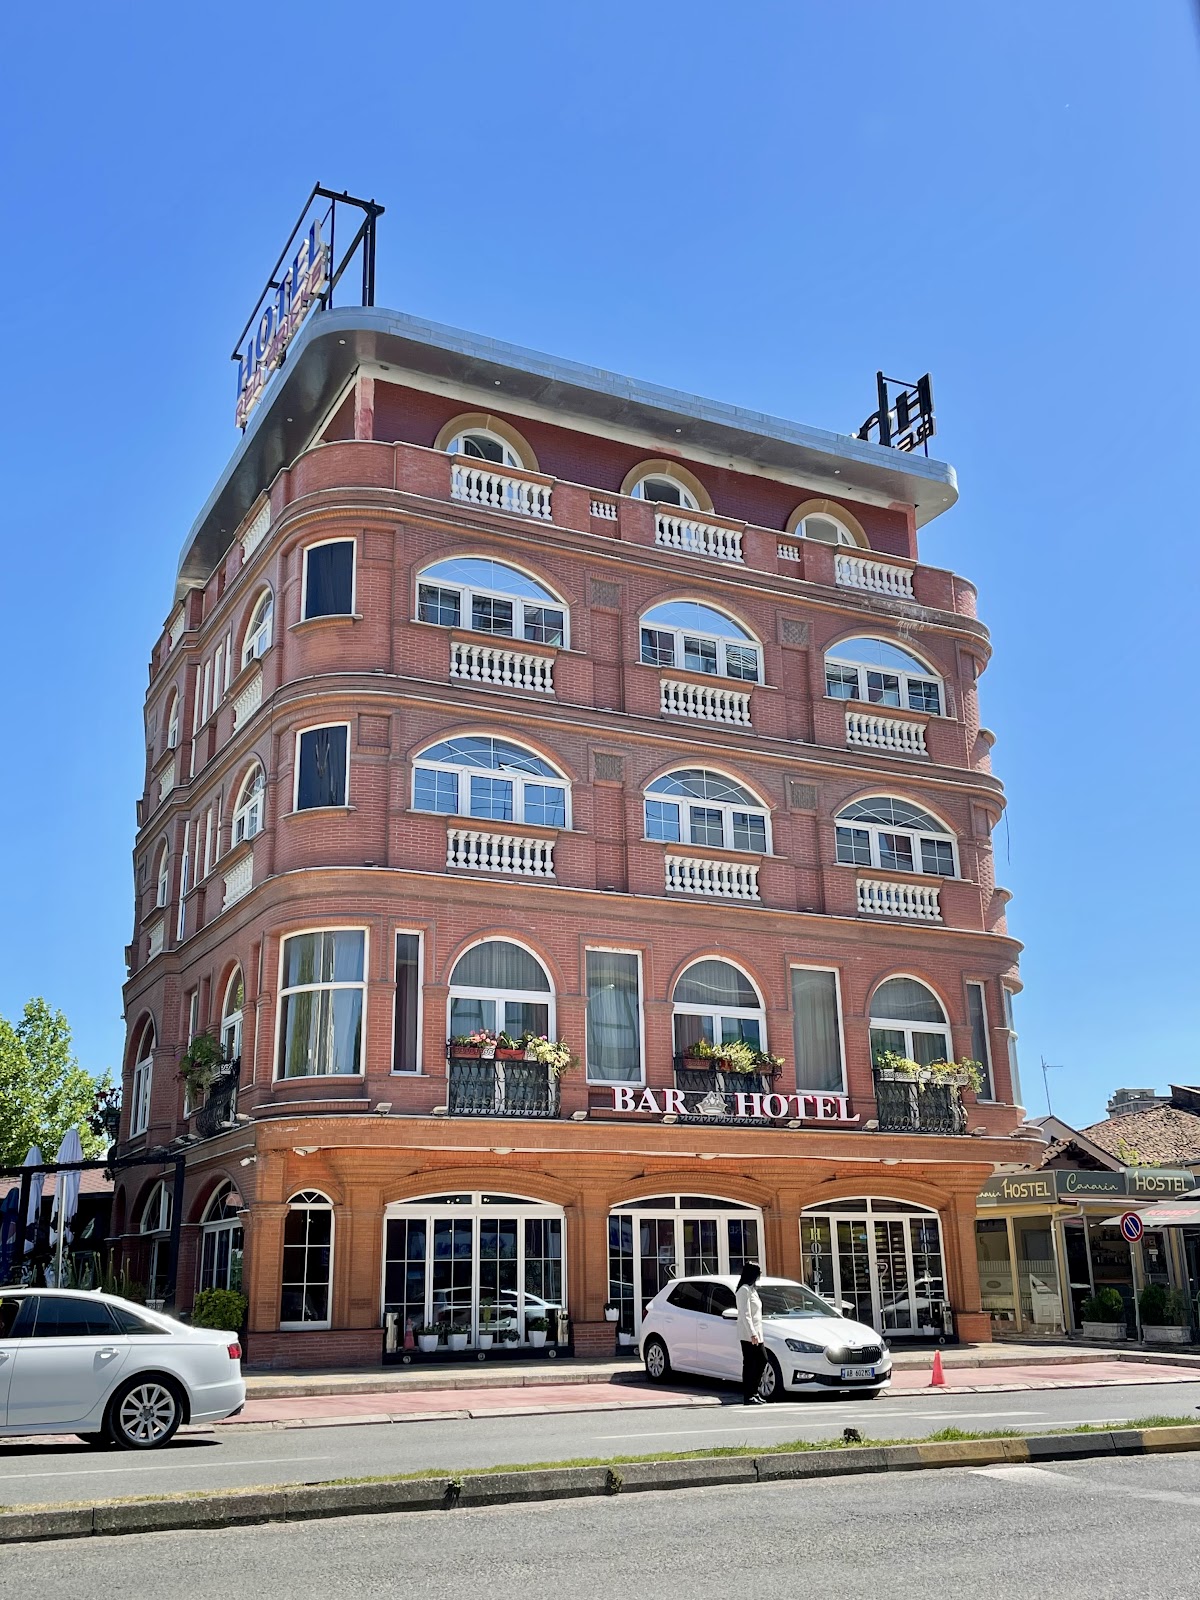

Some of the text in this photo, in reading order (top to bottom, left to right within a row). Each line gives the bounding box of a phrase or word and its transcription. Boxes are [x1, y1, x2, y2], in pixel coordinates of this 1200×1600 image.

[236, 218, 325, 402] HOTEL
[611, 1086, 861, 1122] BAR HOTEL
[1001, 1178, 1051, 1199] HOSTEL
[1132, 1170, 1190, 1192] HOSTEL
